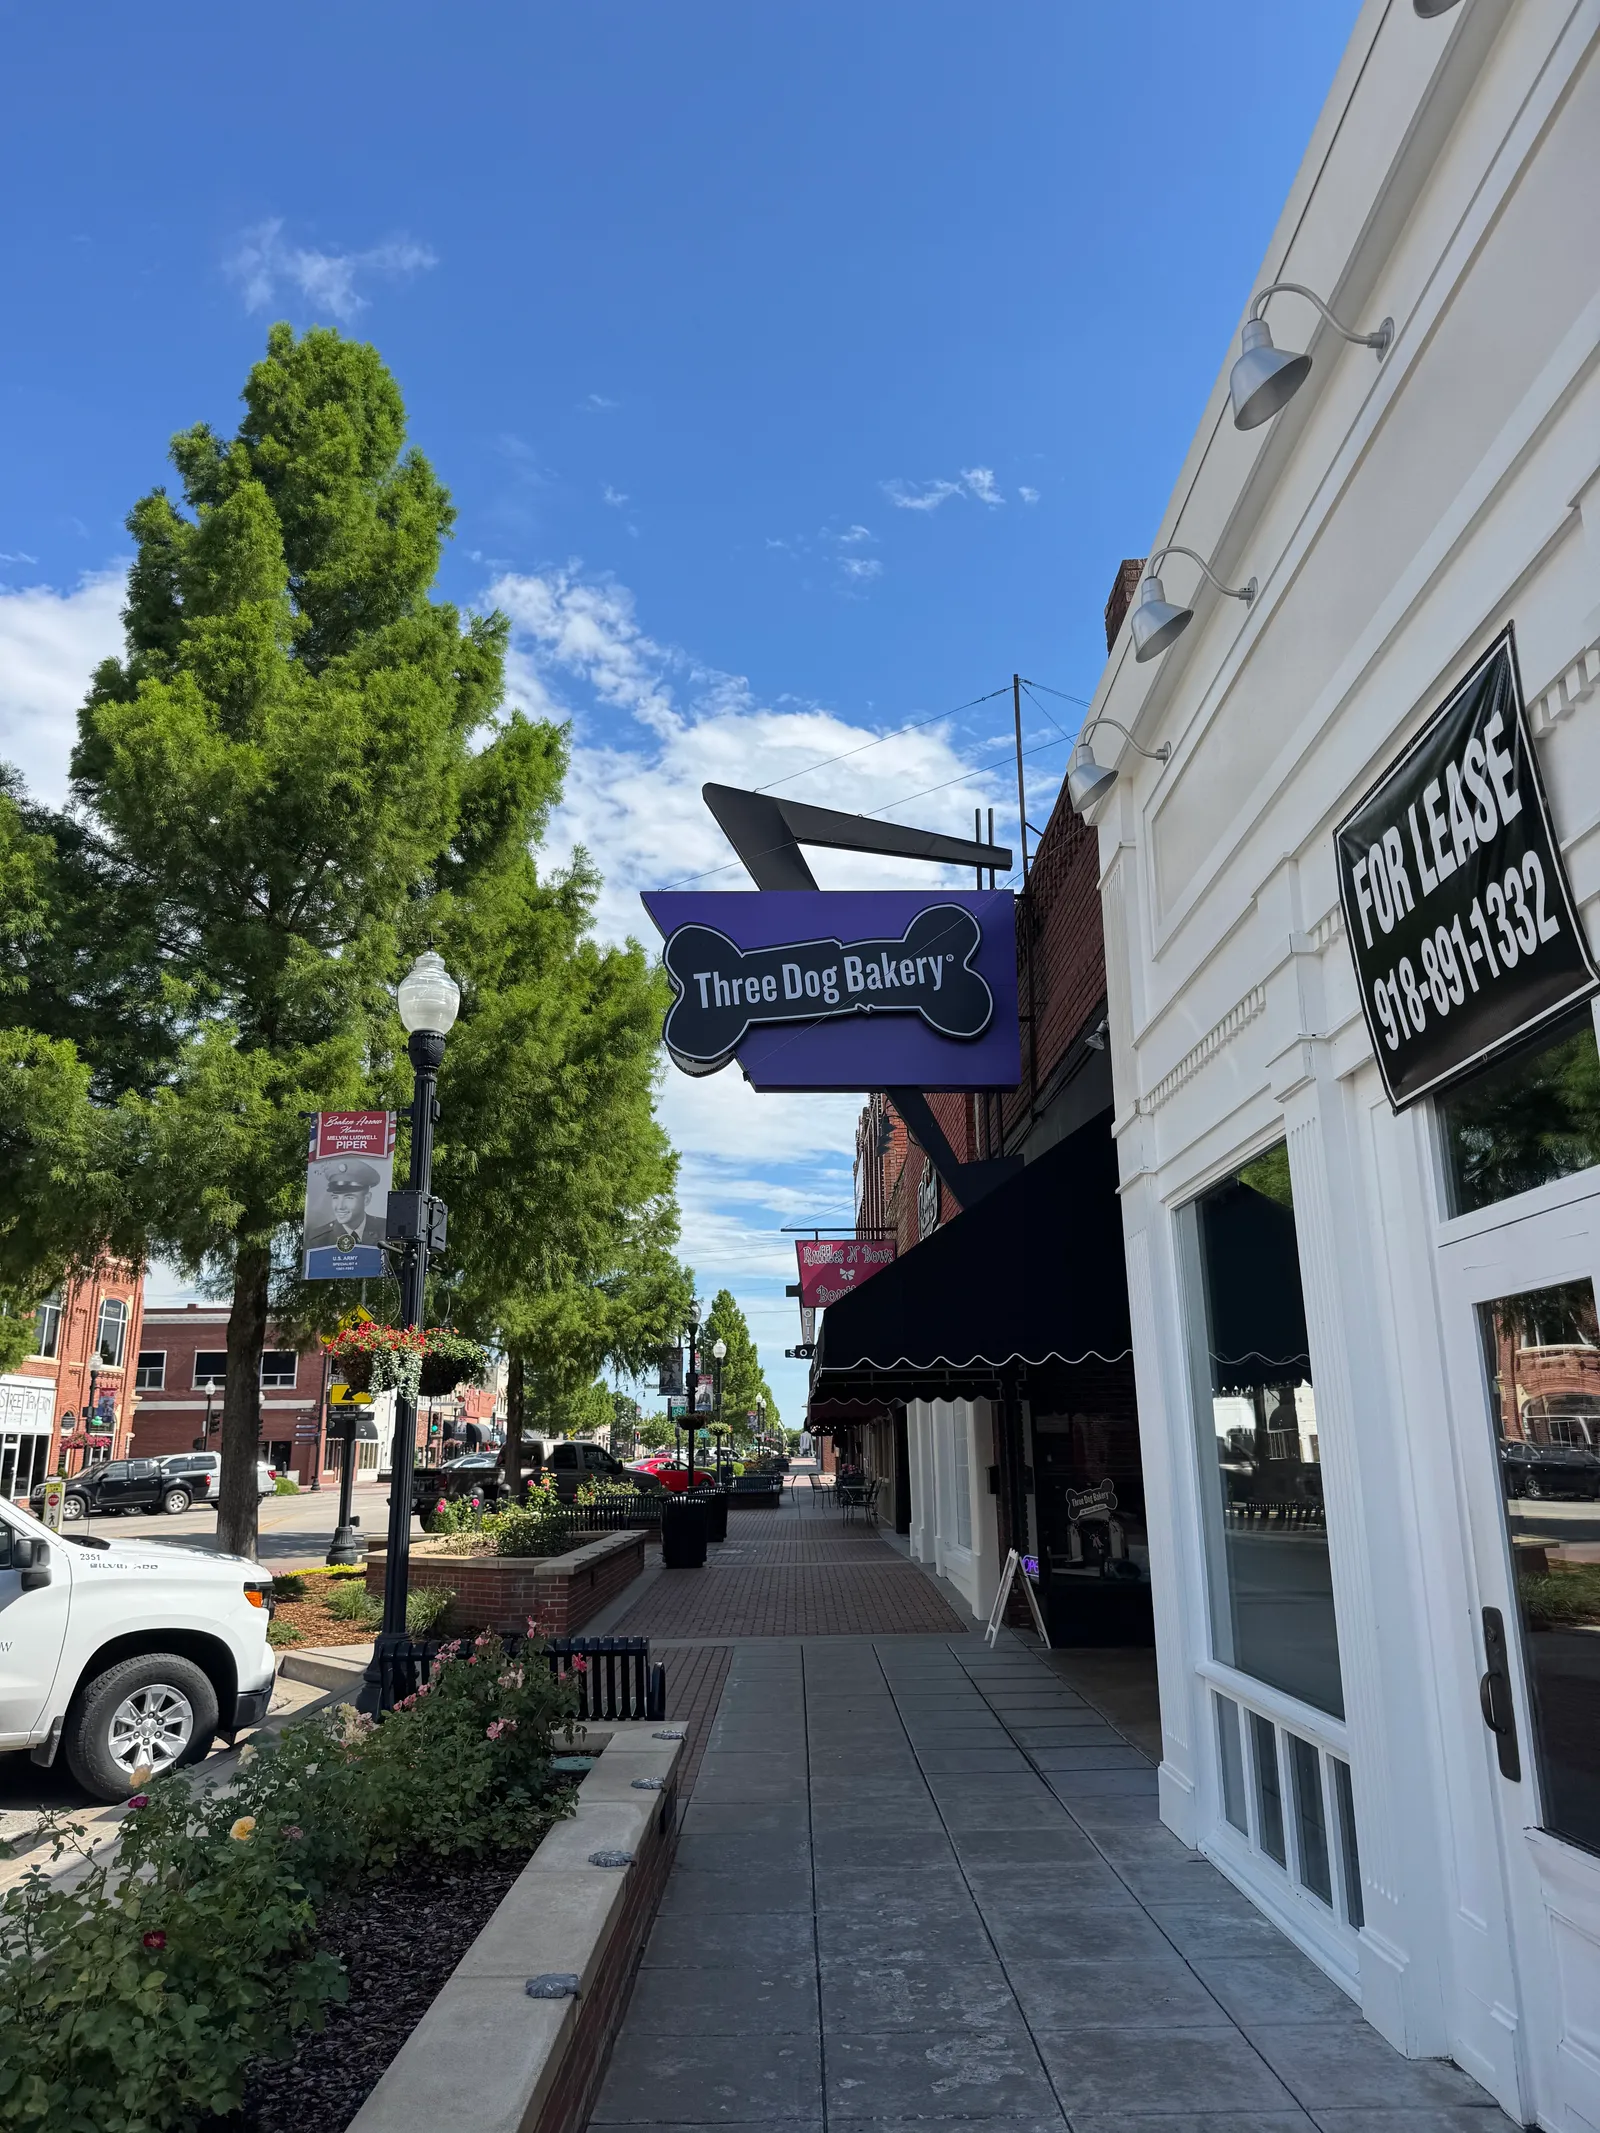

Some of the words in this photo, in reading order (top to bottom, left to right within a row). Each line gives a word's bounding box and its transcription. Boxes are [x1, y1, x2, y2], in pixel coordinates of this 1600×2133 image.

[1352, 825, 1416, 950] FOR
[1407, 709, 1523, 898] LEASE
[1373, 850, 1561, 1052] 918-891-1332
[693, 971, 778, 1009] Three
[782, 962, 840, 1005] Dog
[323, 1115, 354, 1128] Broken
[355, 1115, 383, 1127] Arrow
[336, 1140, 368, 1150] PIPER
[802, 1244, 844, 1266] Ruffles
[861, 1244, 894, 1264] Bows
[1071, 1498, 1085, 1508] Three
[1083, 1494, 1094, 1505] Dog
[1092, 1491, 1109, 1502] Bakery
[80, 1553, 101, 1561] 2351
[1022, 1558, 1040, 1574] OPE
